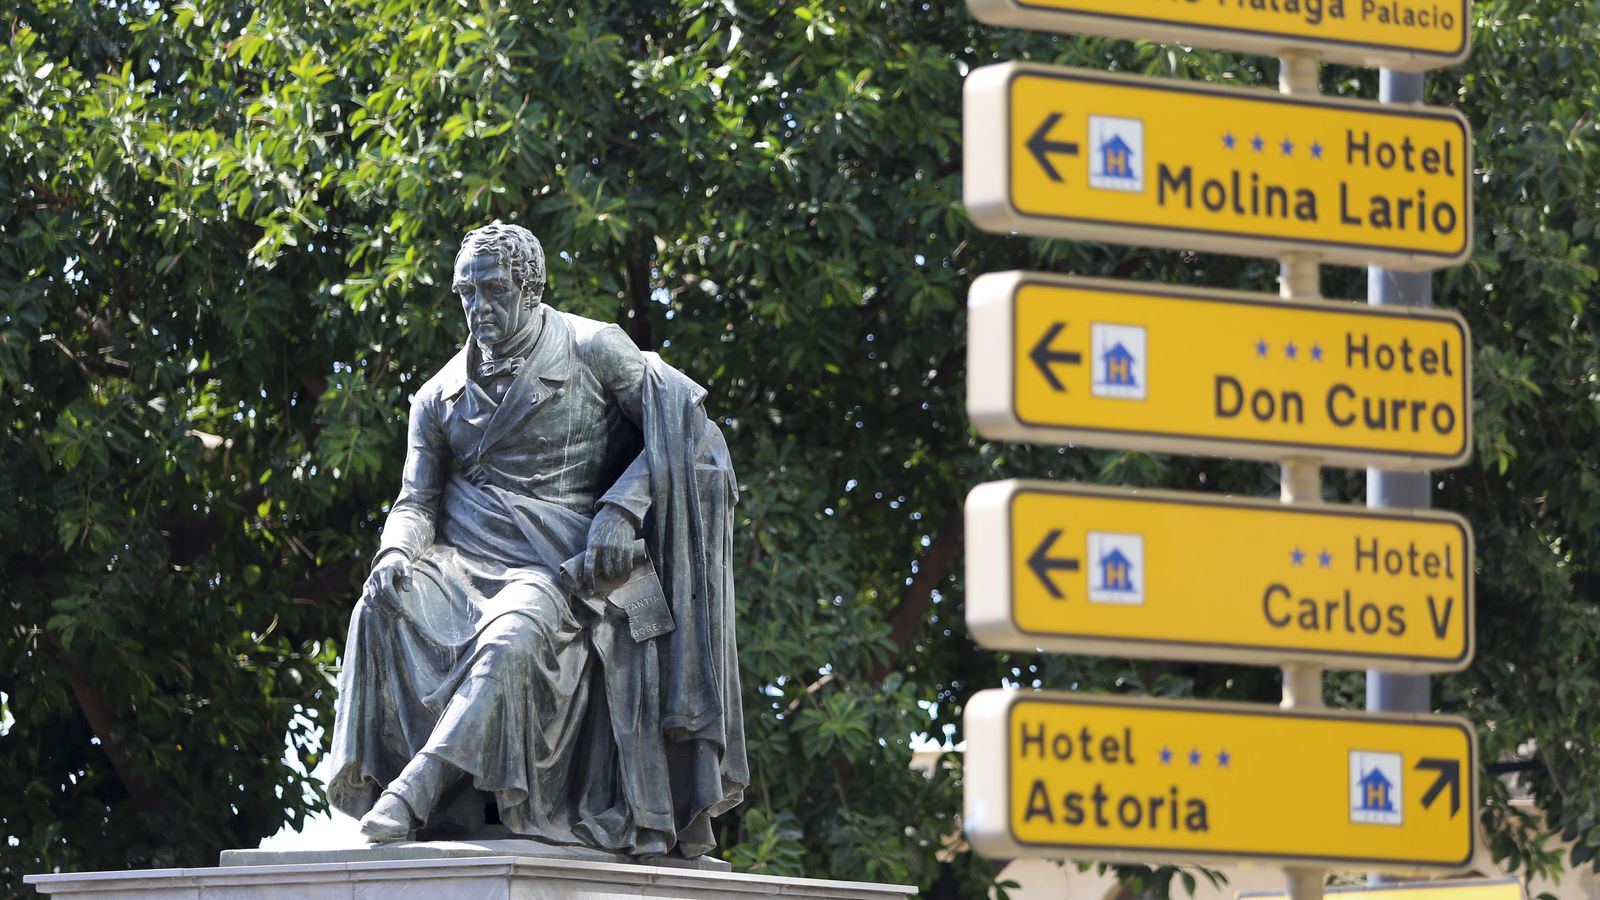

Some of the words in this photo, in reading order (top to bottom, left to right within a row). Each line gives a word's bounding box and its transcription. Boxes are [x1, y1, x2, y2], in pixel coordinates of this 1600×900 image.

[1361, 0, 1455, 31] Palacio
[1346, 129, 1456, 178] Hotel
[1157, 162, 1319, 223] Molina
[1339, 181, 1458, 236] Lario
[1345, 332, 1454, 378] Hotel
[1214, 374, 1305, 424] Don
[1325, 382, 1456, 435] Curro
[1355, 538, 1454, 579] Hotel
[1262, 583, 1407, 637] Carlos
[1426, 595, 1454, 640] V
[1021, 724, 1135, 765] Hotel
[1023, 778, 1210, 833] Astoria
